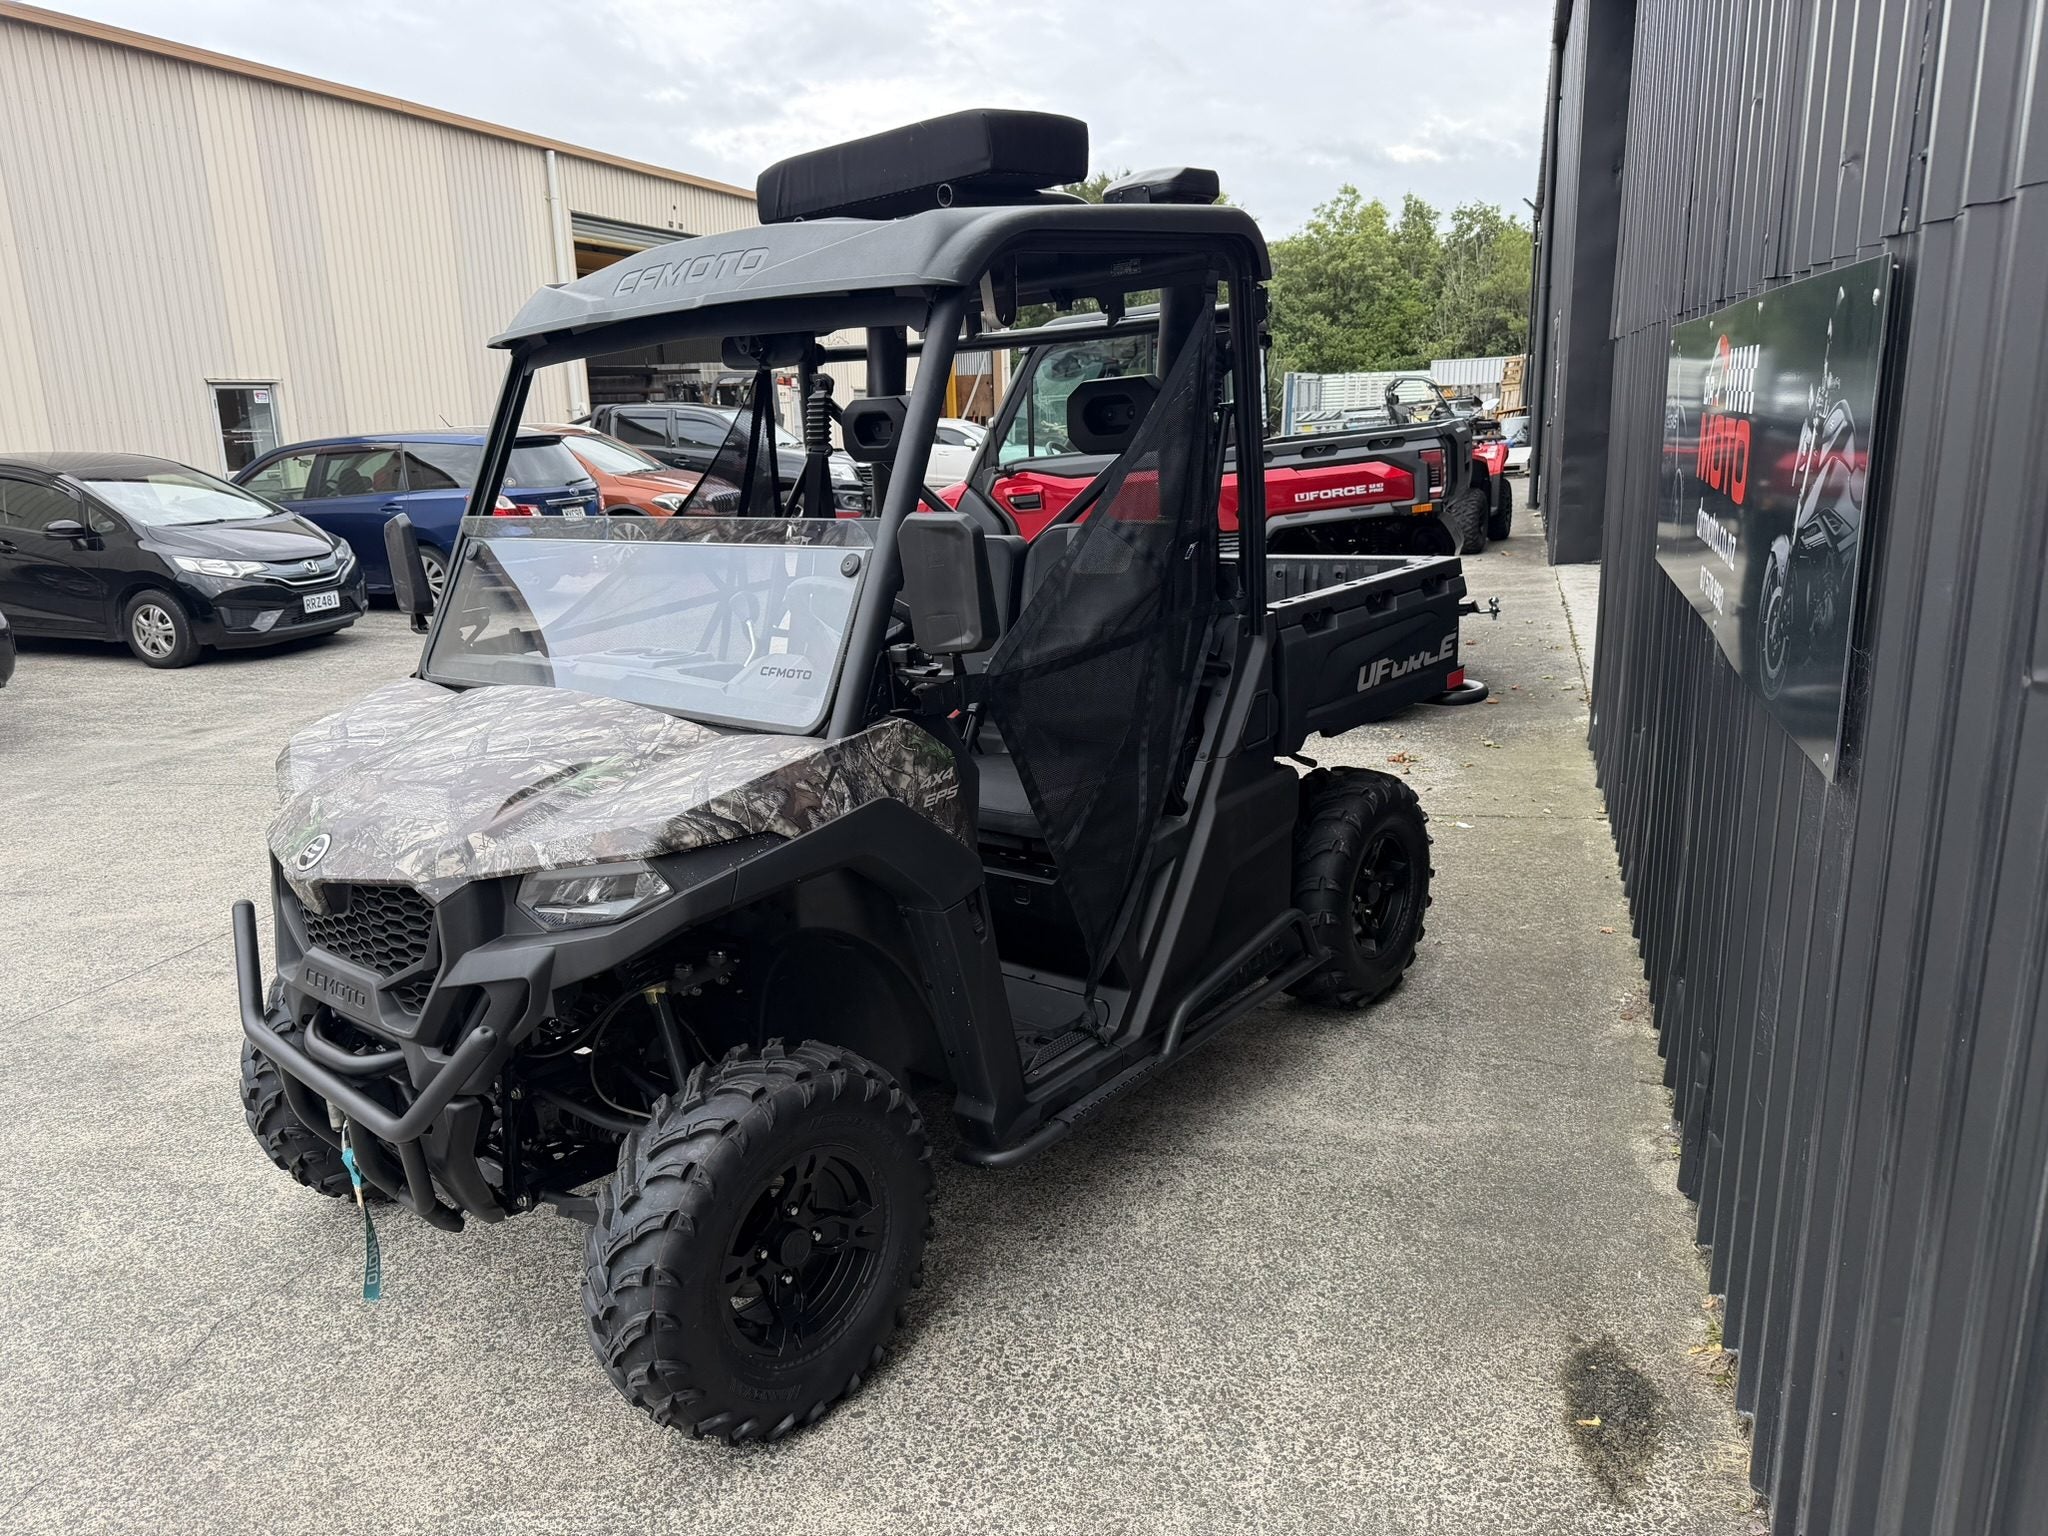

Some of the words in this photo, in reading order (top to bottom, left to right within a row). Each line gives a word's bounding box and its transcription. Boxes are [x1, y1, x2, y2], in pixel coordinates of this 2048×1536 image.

[612, 247, 769, 298] CFMOTO
[1696, 412, 1751, 505] MOTO
[1294, 485, 1367, 503] UFORCE
[760, 666, 812, 680] CFMOTO
[923, 784, 959, 808] EPS
[306, 967, 366, 1010] CFMOTO
